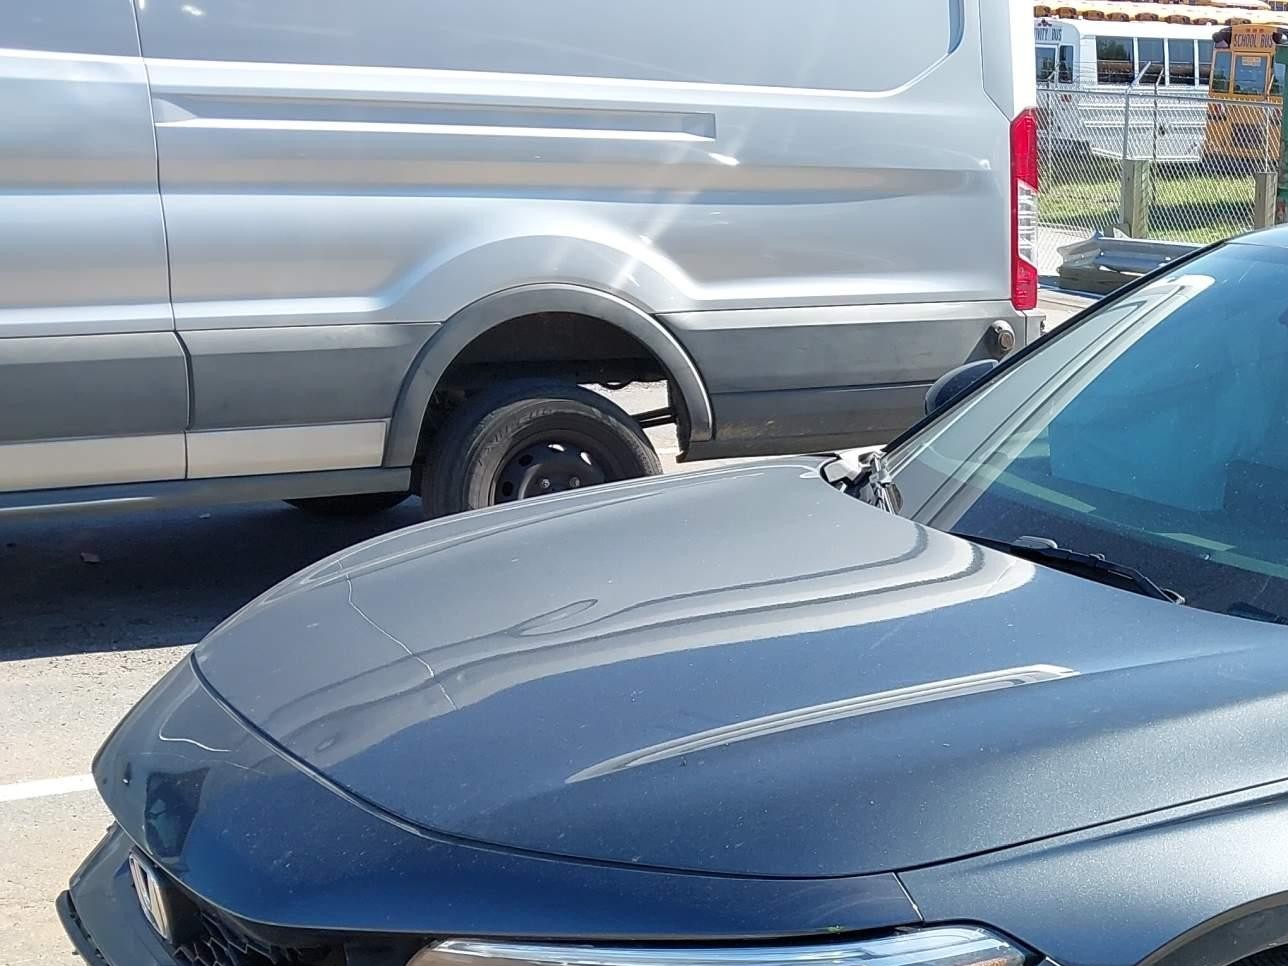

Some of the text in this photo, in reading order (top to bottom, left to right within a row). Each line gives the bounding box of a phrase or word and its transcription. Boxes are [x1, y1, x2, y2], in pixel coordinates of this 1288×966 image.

[1051, 28, 1062, 41] BUS
[1233, 33, 1273, 48] SCHOOL BUS
